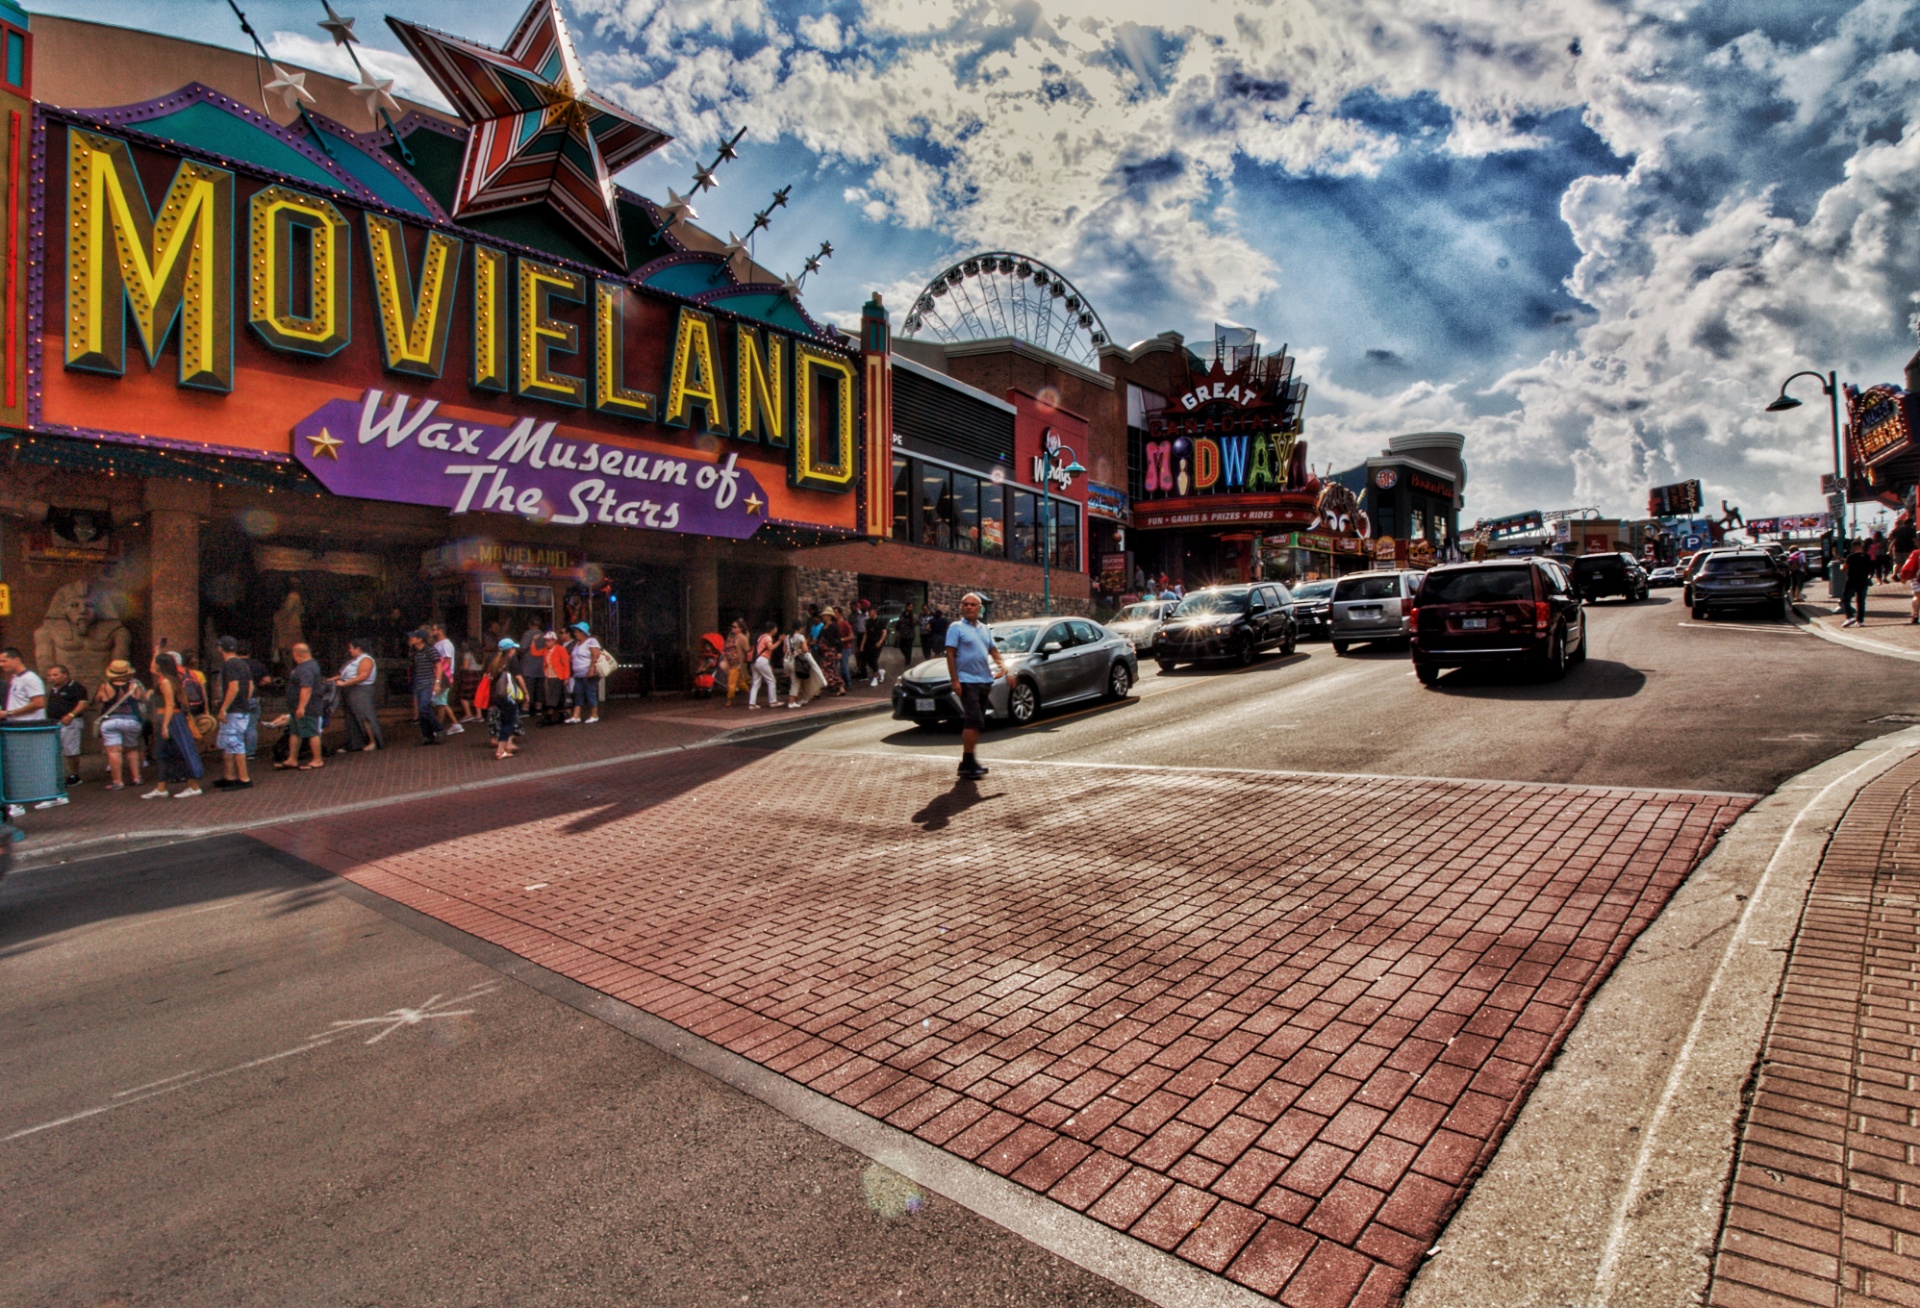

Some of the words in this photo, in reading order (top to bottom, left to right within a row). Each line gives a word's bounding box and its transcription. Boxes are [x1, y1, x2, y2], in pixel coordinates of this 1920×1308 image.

[65, 126, 858, 493] MOVIELAND
[1181, 382, 1257, 411] GREAT
[1150, 412, 1284, 438] CANADIAN
[358, 389, 480, 455] Wax
[489, 417, 688, 486] Museum
[695, 453, 742, 510] of
[1410, 473, 1438, 492] Boston
[445, 464, 541, 516] The
[551, 478, 681, 530] Stars
[1148, 516, 1163, 526] FUN
[1171, 514, 1200, 524] GAMES
[1211, 511, 1240, 522] PRIZES
[1249, 510, 1274, 520] RIDES
[1687, 537, 1699, 548] P
[480, 545, 568, 570] MOVIELAND
